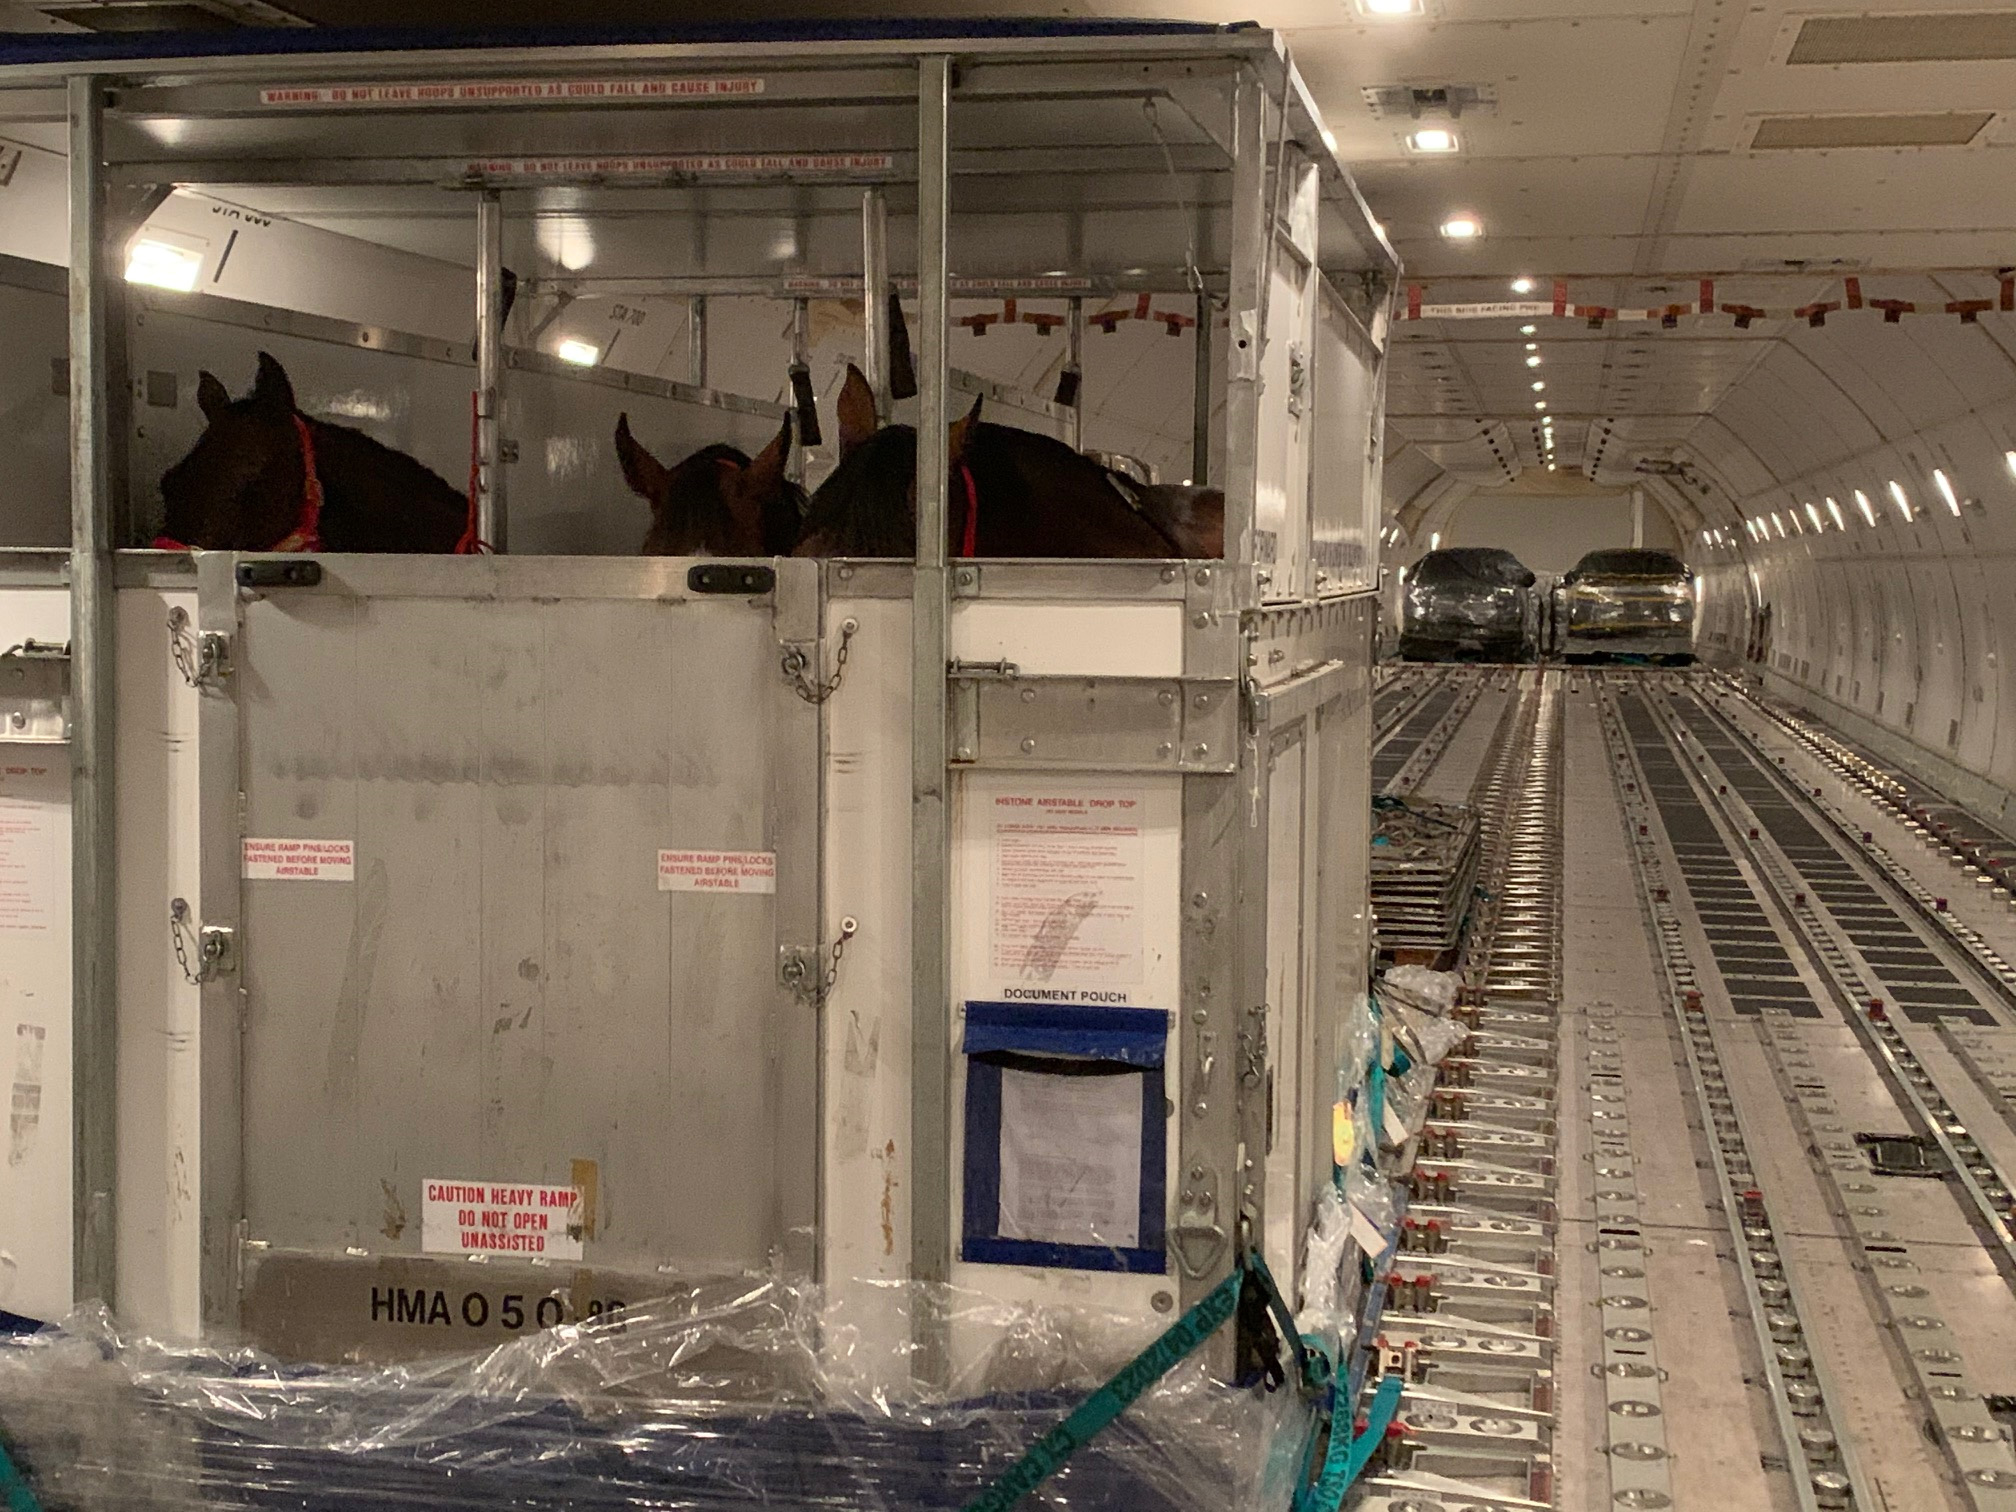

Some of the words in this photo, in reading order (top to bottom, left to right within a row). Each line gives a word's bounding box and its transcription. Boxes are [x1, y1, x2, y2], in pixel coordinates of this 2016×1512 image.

[331, 89, 347, 100] DO
[351, 88, 373, 99] NOT
[378, 87, 412, 99] LEAVE
[418, 86, 454, 98] HOOPS
[460, 83, 542, 97] UNSUPPORTED
[547, 83, 562, 95] AS
[568, 82, 604, 95] COULD
[609, 82, 634, 94] FALL
[642, 81, 666, 93] AND
[671, 81, 708, 93] CAUSE
[715, 80, 757, 92] INJURY
[1037, 798, 1083, 807] AIRSTABLE
[1089, 799, 1115, 808] DROP
[1118, 800, 1137, 808] TOP
[244, 842, 276, 852] ENSURE
[278, 843, 301, 852] RAMP
[243, 854, 284, 863] FASTENED
[286, 855, 318, 864] BEFORE
[320, 855, 351, 865] MOVING
[661, 853, 694, 863] ENSURE
[696, 854, 721, 863] RAMP
[276, 866, 319, 876] AIRSTABLE
[660, 865, 703, 876] FASTENED
[705, 866, 738, 876] BEFORE
[741, 867, 775, 877] MOVING
[694, 878, 740, 888] AIRSTABLE
[1004, 988, 1077, 1001] DOCUMENT
[1081, 991, 1127, 1003] POUCH
[428, 1184, 485, 1204] CAUTION
[491, 1188, 534, 1206] HEAVY
[540, 1190, 578, 1208] RAMP
[458, 1209, 475, 1226] DO
[482, 1211, 508, 1228] NOT
[514, 1212, 548, 1230] OPEN
[461, 1231, 545, 1252] UNASSISTED
